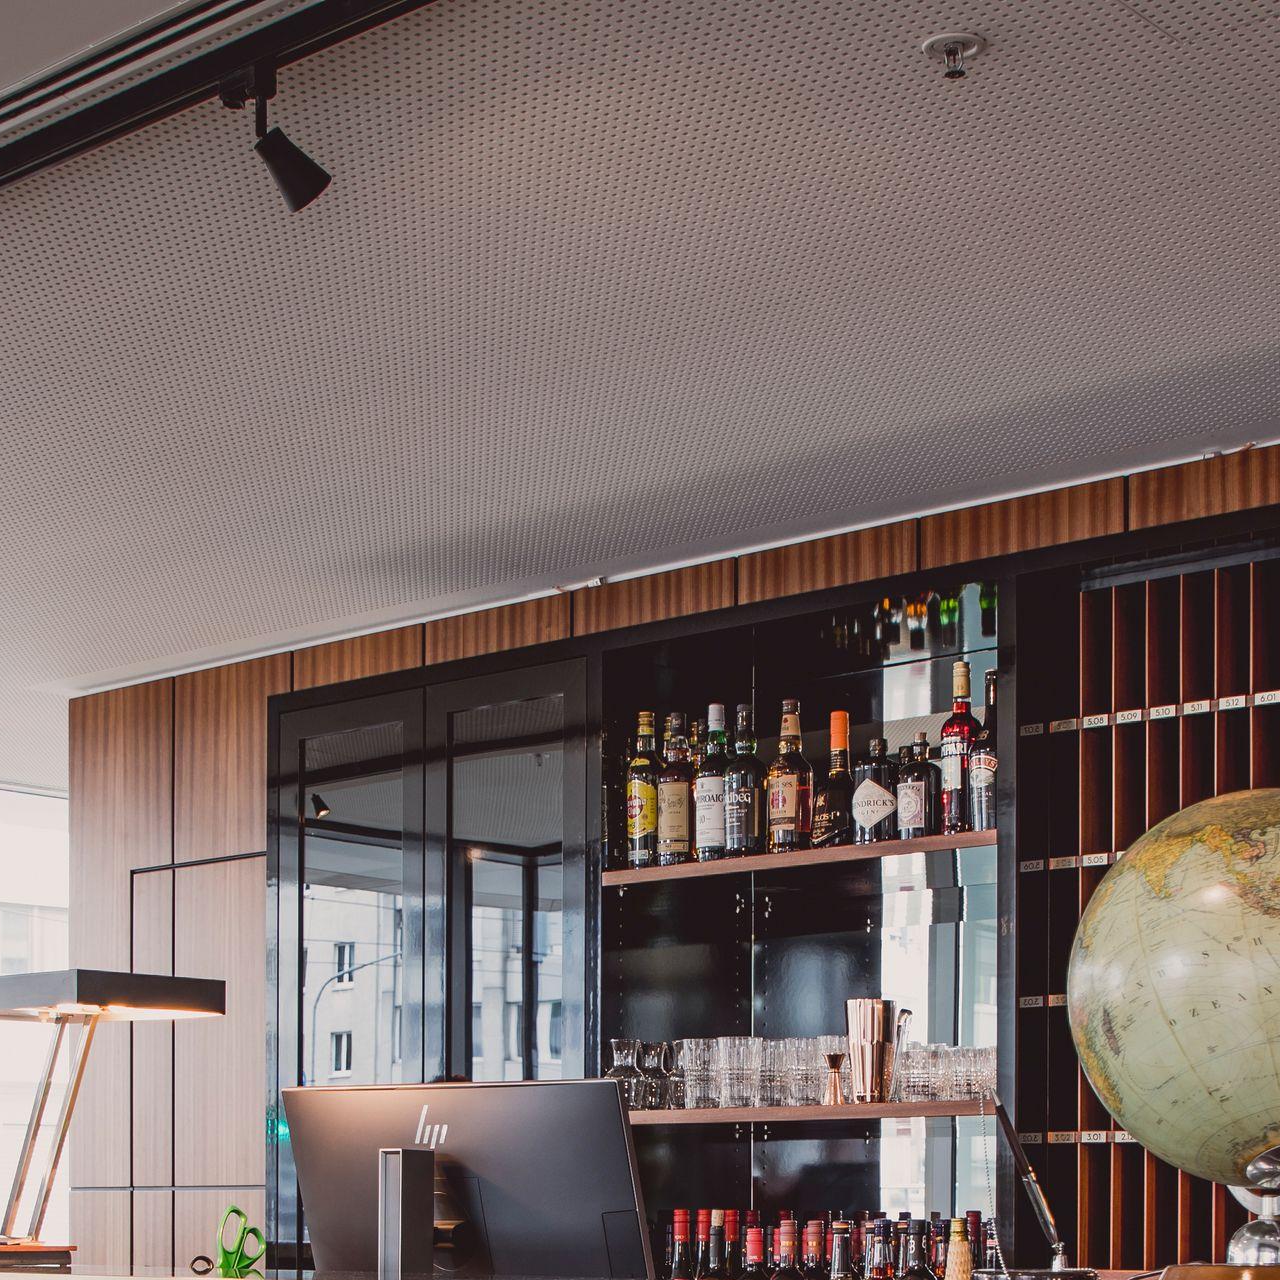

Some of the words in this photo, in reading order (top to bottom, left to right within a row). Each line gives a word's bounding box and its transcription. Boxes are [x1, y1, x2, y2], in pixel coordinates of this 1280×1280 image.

[1225, 698, 1239, 707] 5.12
[1260, 693, 1276, 703] 6.01
[1155, 707, 1170, 717] 5.10
[1191, 703, 1203, 712] 5.11
[1087, 716, 1104, 726] 5.08
[1120, 712, 1138, 722] 5.09
[1087, 856, 1104, 865] 5.05
[414, 1104, 448, 1149] hp
[1087, 1133, 1101, 1141] 3.01
